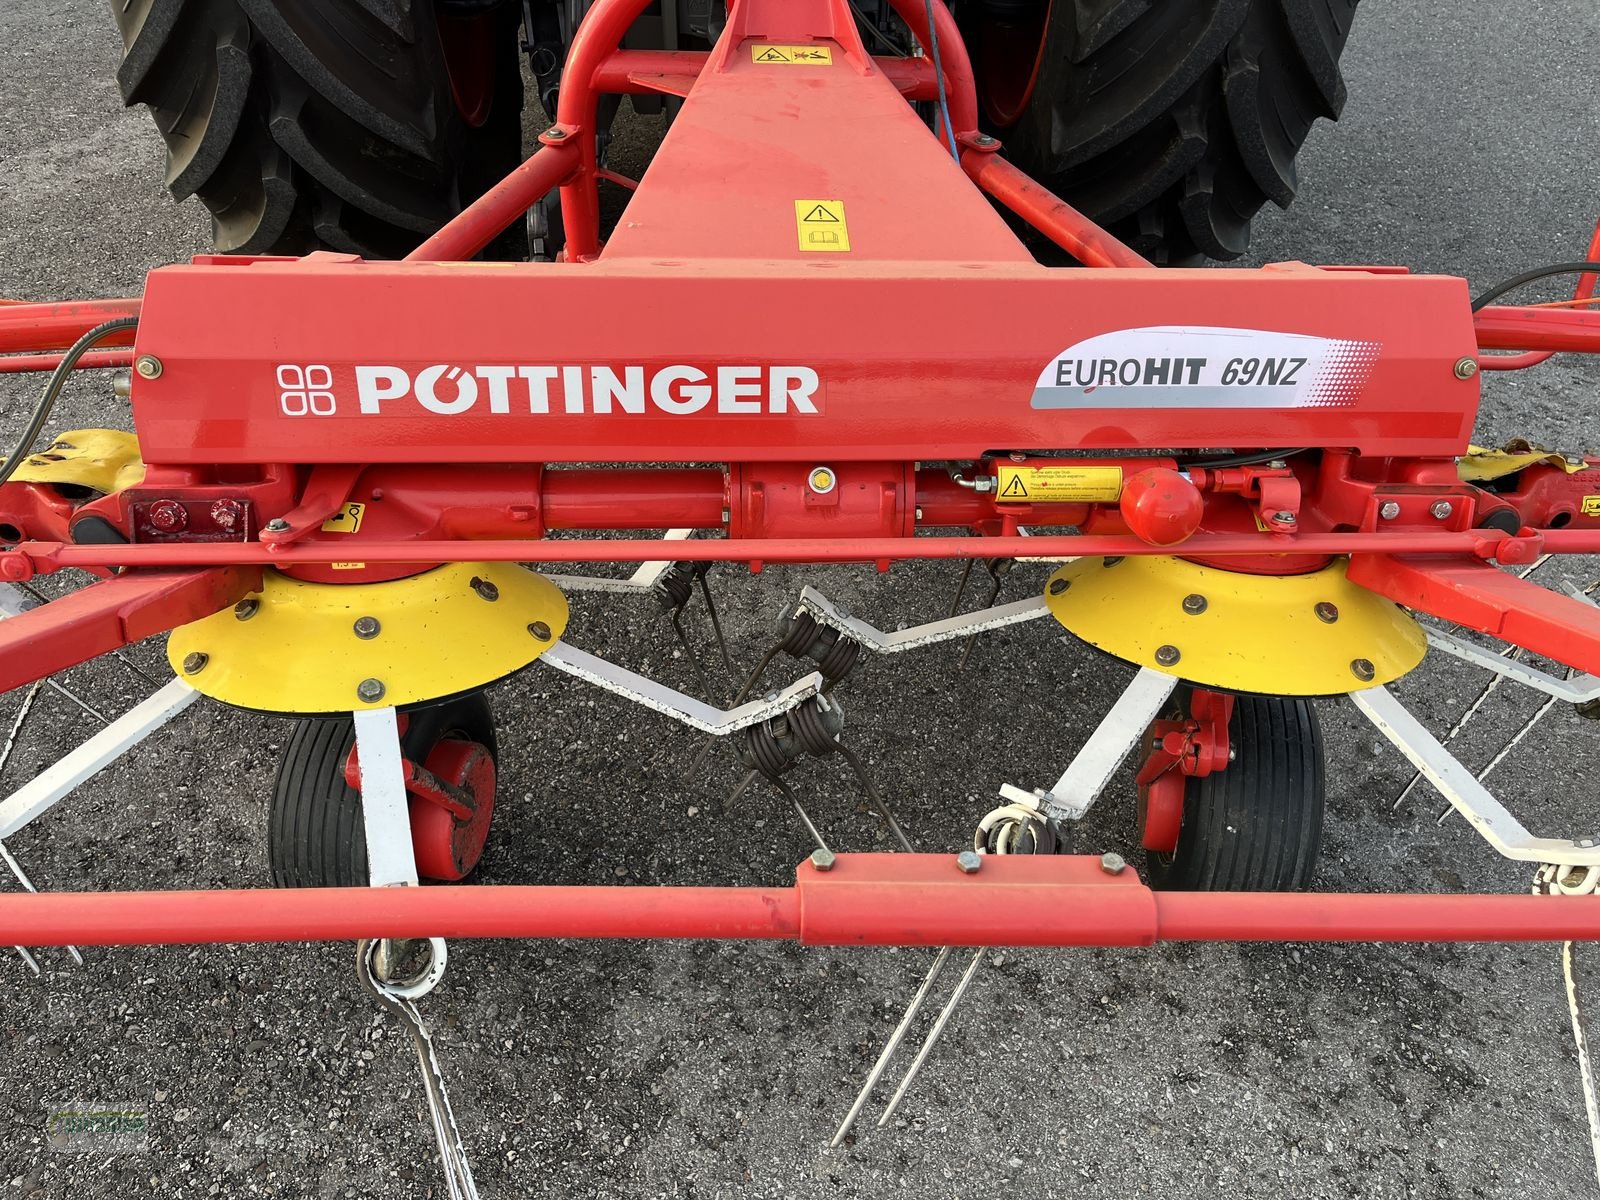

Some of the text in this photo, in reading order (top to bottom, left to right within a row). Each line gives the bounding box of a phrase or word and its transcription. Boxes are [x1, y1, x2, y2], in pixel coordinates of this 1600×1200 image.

[355, 365, 819, 415] PÖTTINGER
[1055, 358, 1308, 387] EUROHIT 69NZ
